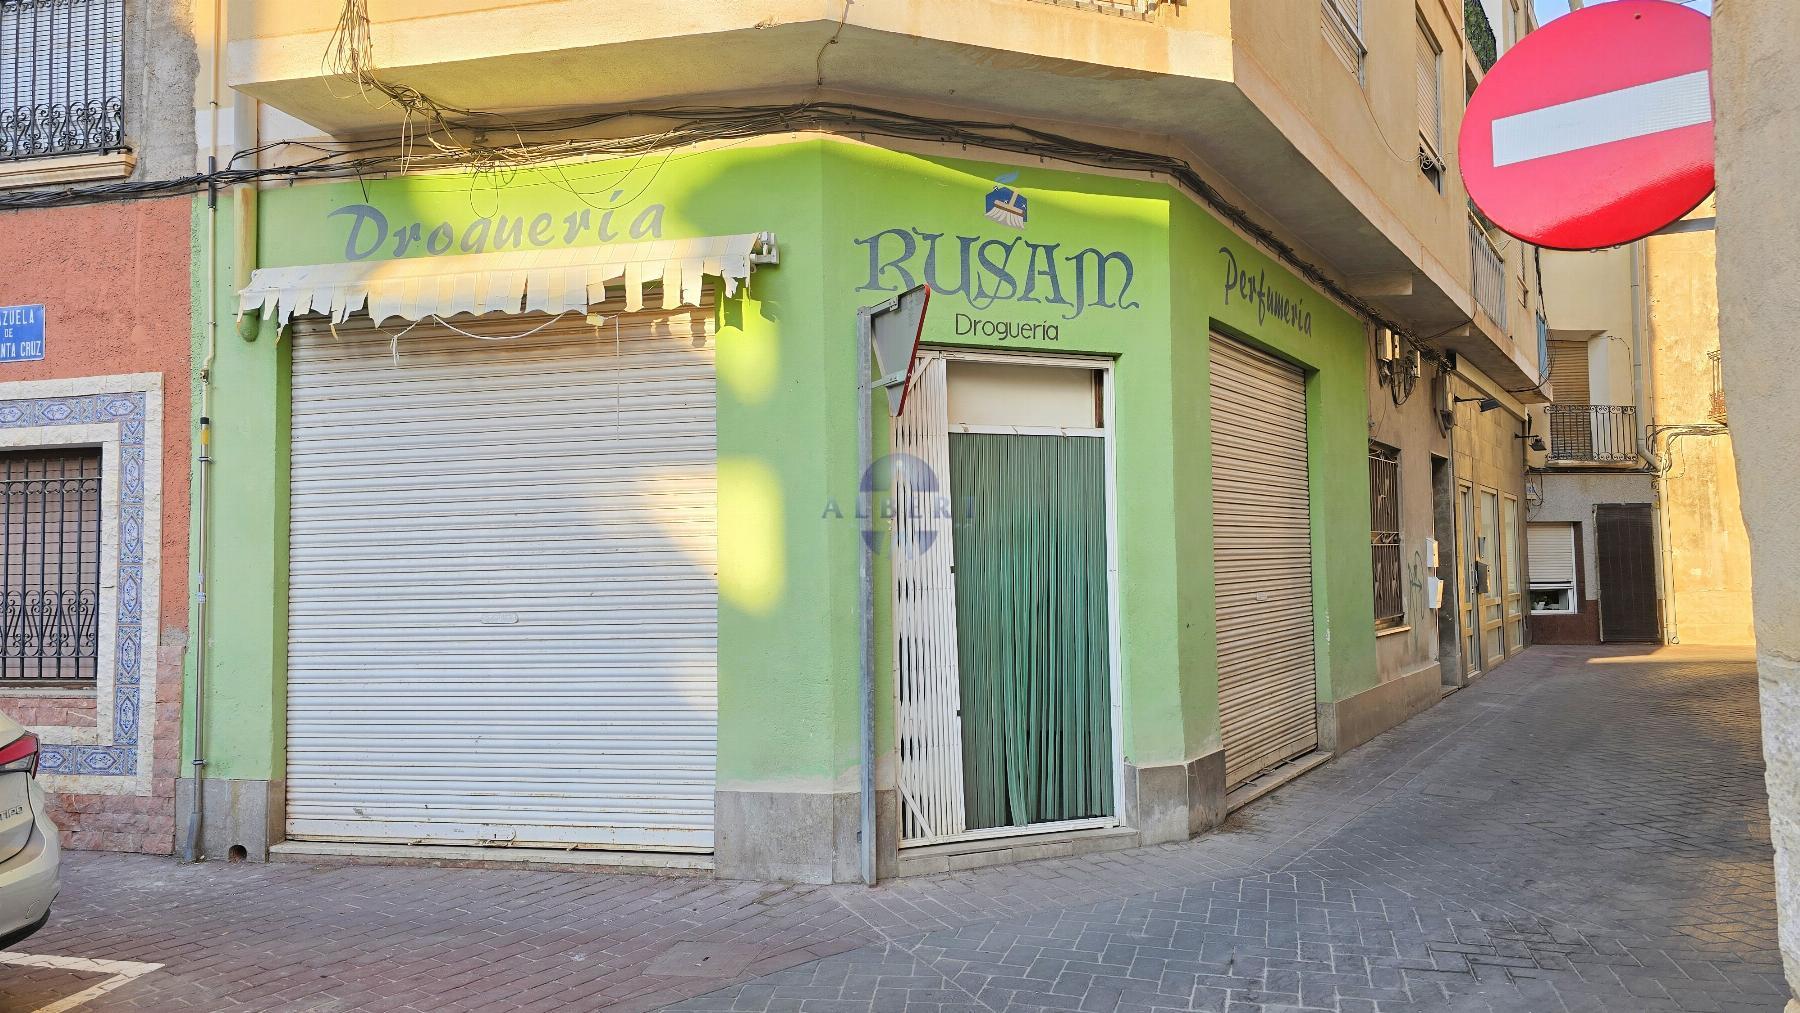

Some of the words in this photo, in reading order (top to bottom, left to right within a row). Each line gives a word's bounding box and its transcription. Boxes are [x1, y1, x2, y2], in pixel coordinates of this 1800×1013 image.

[854, 226, 1140, 320] RUSAM
[0, 309, 35, 326] ZUELA
[4, 328, 14, 338] DE
[955, 313, 1059, 341] Droguería
[20, 340, 42, 357] CRUZ
